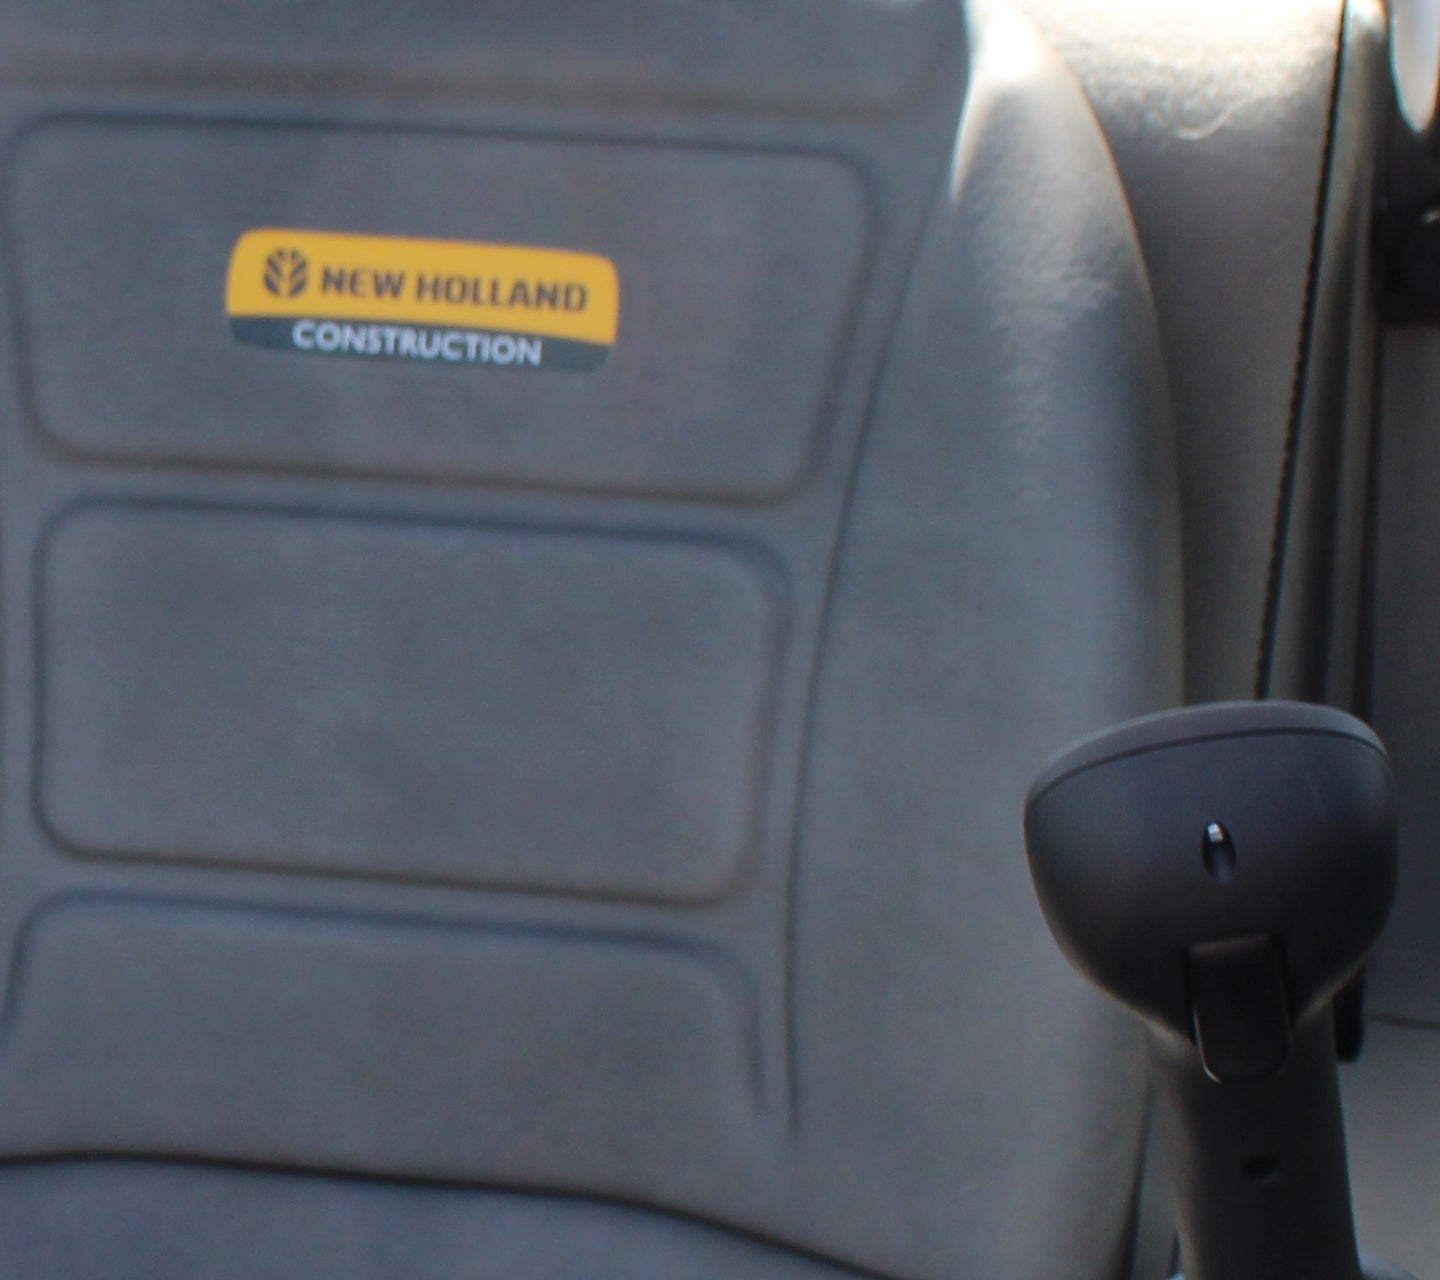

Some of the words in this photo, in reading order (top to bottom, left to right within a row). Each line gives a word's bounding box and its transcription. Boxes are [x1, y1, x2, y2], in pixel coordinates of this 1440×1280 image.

[320, 266, 406, 299] NEW
[415, 272, 588, 313] HOLLAND
[291, 319, 543, 366] CONSTRUCTION
